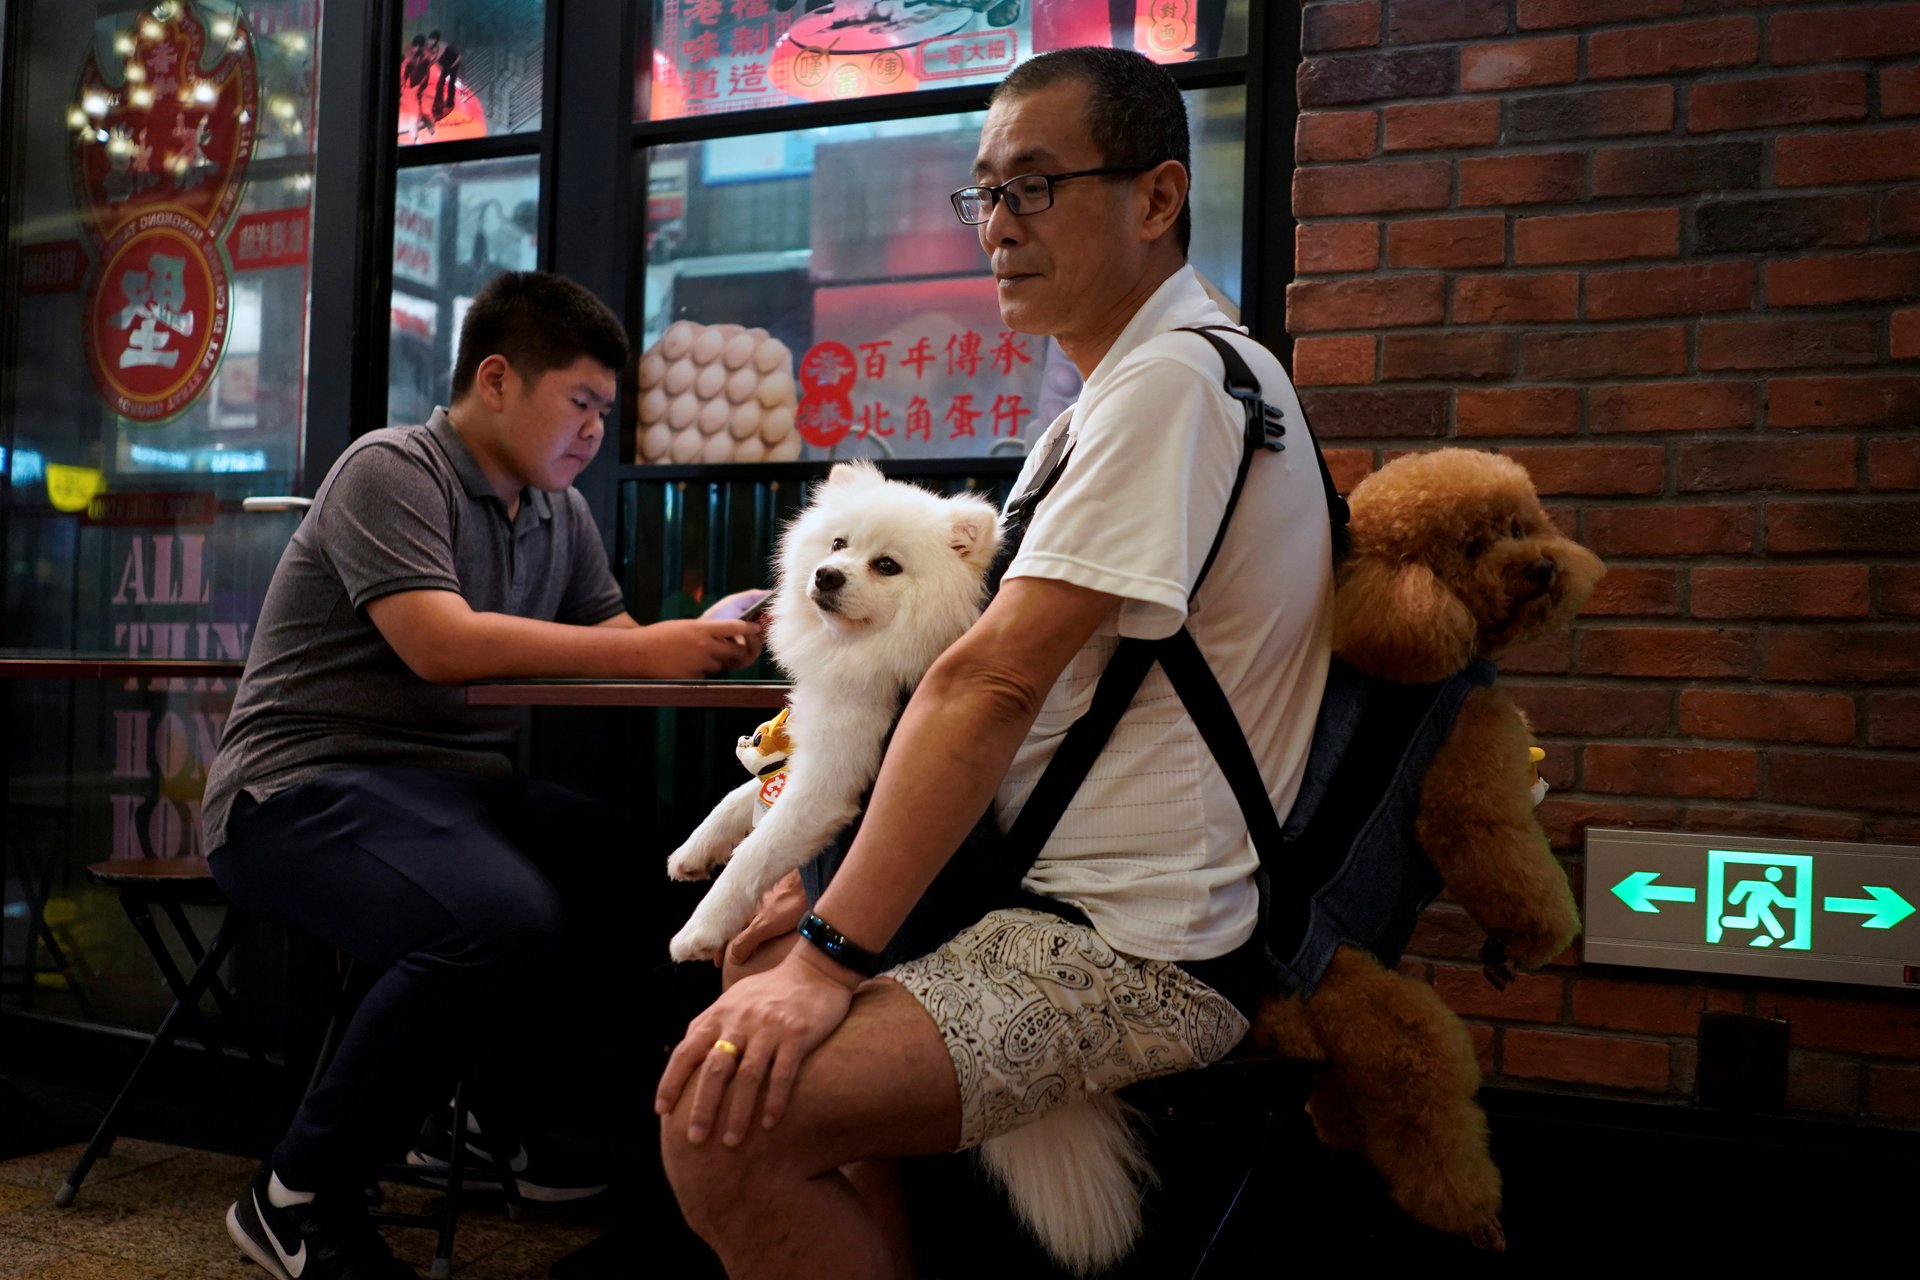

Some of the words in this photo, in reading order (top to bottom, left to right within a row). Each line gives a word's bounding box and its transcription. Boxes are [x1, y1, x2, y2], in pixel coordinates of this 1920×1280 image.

[857, 330, 1032, 381] 百年傳承
[855, 394, 1032, 441] 北角蛋仔
[112, 535, 210, 604] ALL
